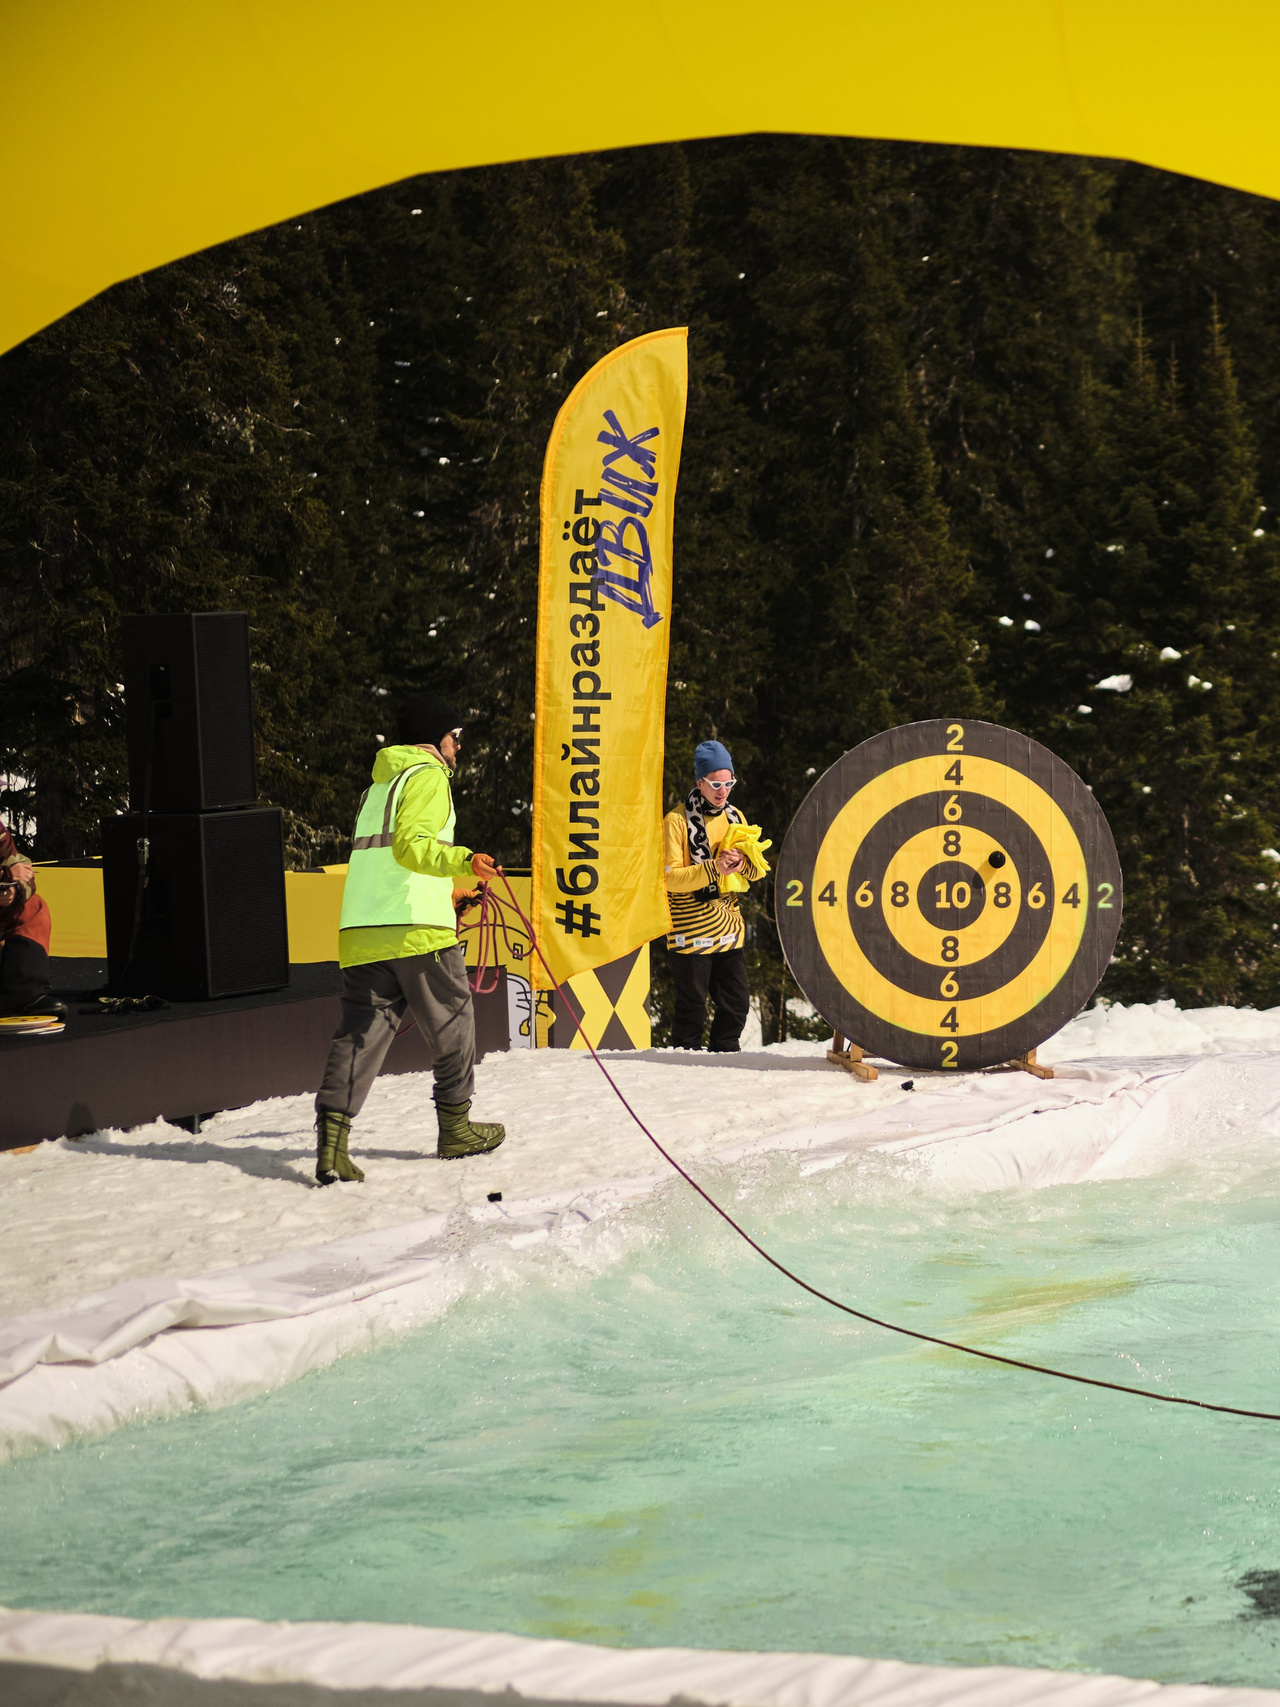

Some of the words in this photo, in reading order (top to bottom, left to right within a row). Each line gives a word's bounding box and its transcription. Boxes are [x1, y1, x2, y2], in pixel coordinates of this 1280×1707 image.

[596, 409, 662, 630] ДВИЖ
[554, 488, 612, 938] #билайнраздаёт
[945, 723, 965, 752] 2
[944, 759, 964, 786] 4
[942, 794, 963, 822] 6
[942, 830, 961, 857] 8
[786, 879, 804, 907] 2
[818, 880, 838, 907] 4
[854, 880, 875, 908] 6
[890, 880, 910, 908] 8
[934, 881, 972, 910] 10
[993, 881, 1012, 909] 8
[1026, 881, 1046, 910] 6
[1061, 882, 1081, 909] 4
[1096, 882, 1115, 909] 2
[941, 935, 960, 963] 8
[939, 970, 960, 999] 6
[940, 1006, 960, 1033] 4
[940, 1040, 959, 1068] 2
